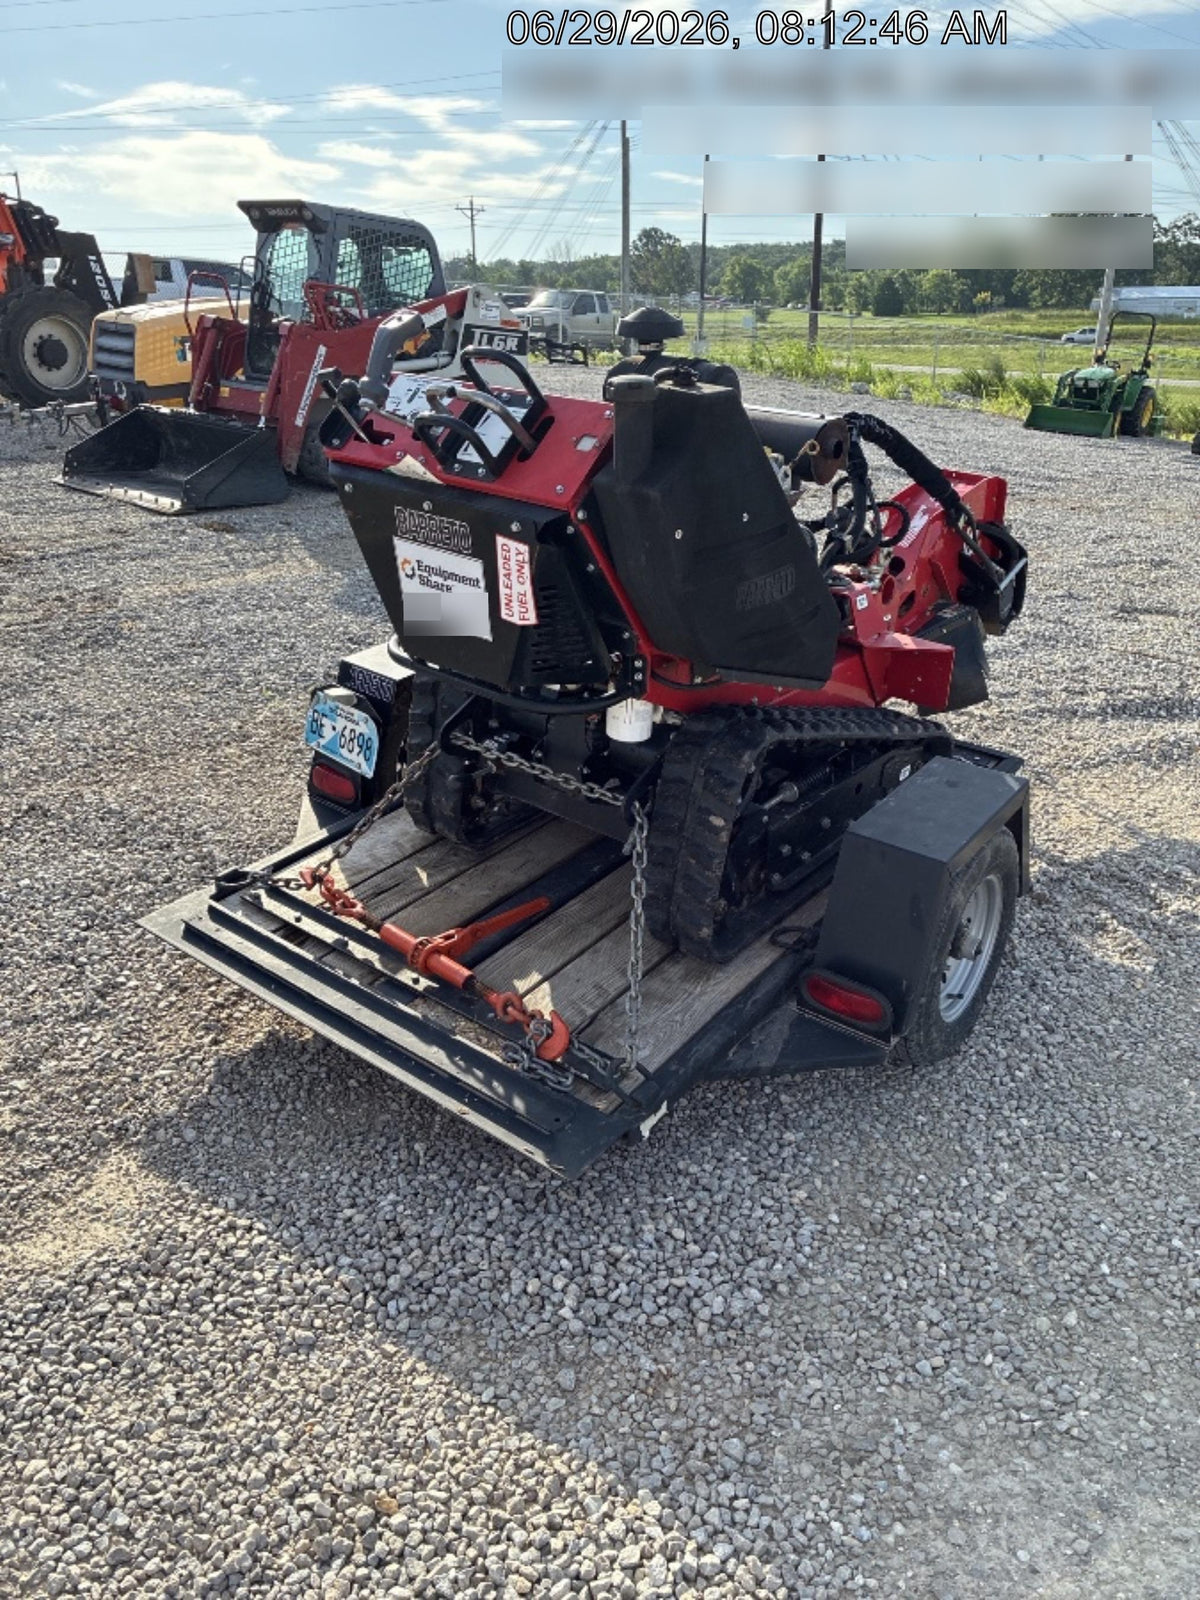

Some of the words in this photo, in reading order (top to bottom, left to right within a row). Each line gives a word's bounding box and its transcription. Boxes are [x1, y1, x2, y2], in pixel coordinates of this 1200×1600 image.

[394, 506, 472, 554] BARRETO
[415, 559, 481, 589] Equipment
[417, 573, 453, 593] Share
[501, 543, 514, 618] UNLEADED
[515, 547, 528, 585] ONLY
[518, 591, 530, 621] FUEL
[339, 724, 373, 762] 6898
